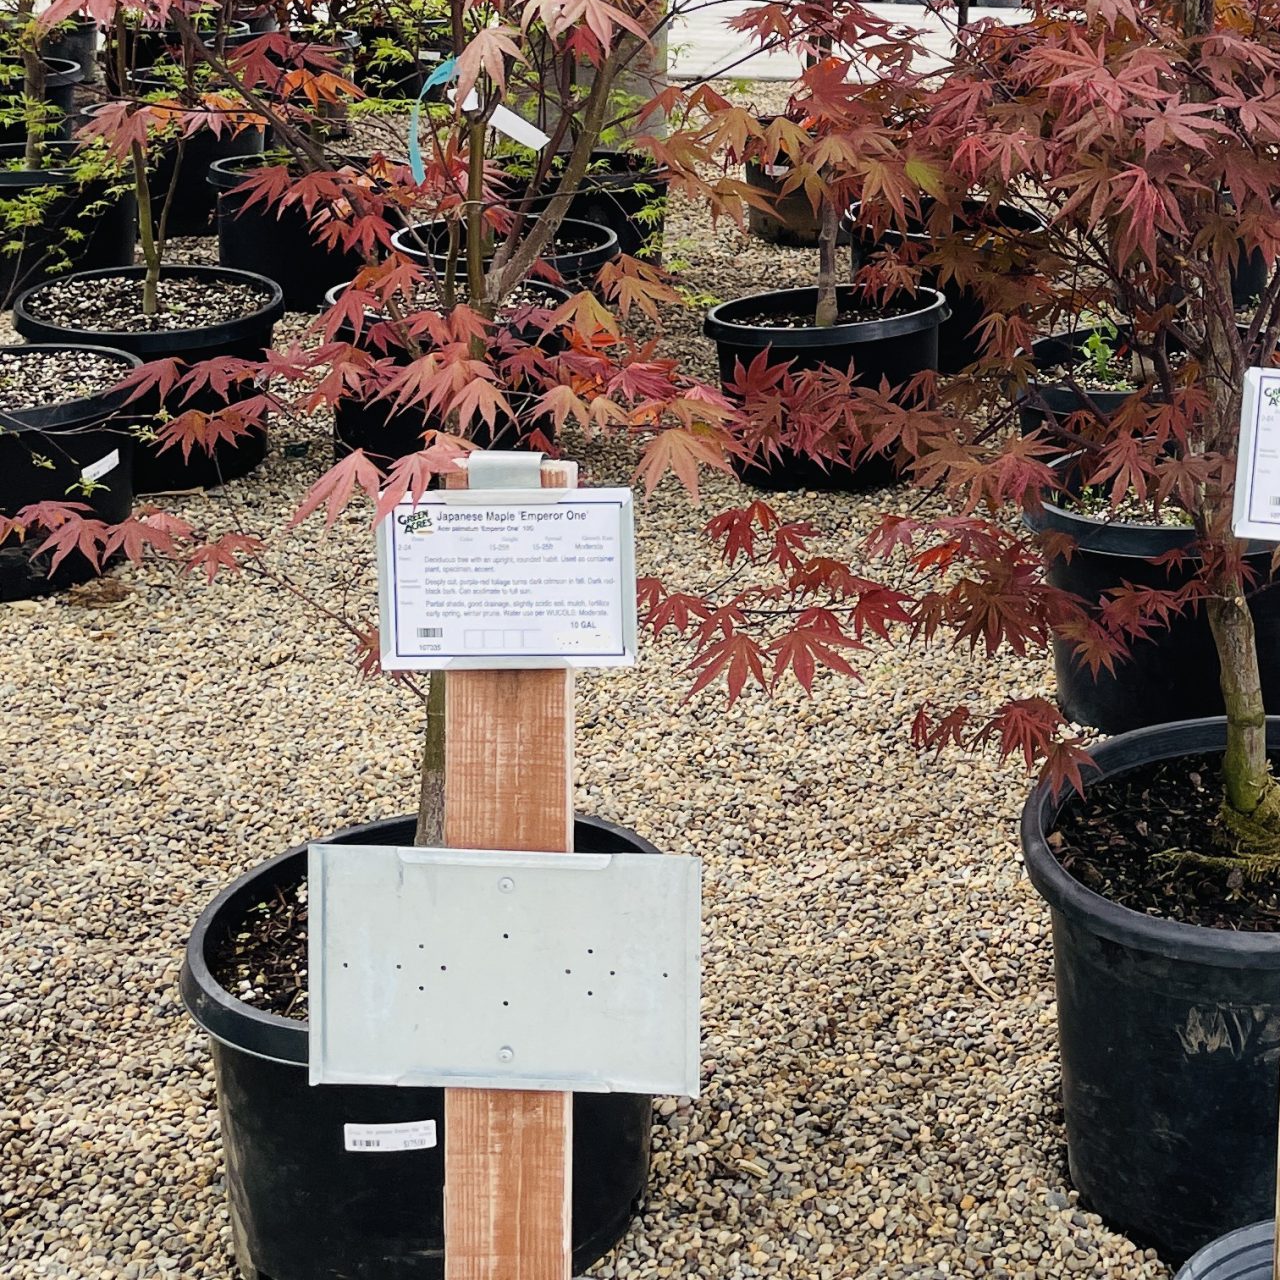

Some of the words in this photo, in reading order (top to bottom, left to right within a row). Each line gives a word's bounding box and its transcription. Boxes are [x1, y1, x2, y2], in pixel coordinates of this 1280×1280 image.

[398, 510, 429, 525] GREEN
[436, 511, 483, 522] Japanese
[486, 511, 516, 522] Maple
[518, 510, 563, 522] 'Emperor
[566, 509, 589, 520] One'
[404, 519, 433, 534] ACRES
[570, 621, 579, 629] 10
[580, 620, 597, 629] GAL
